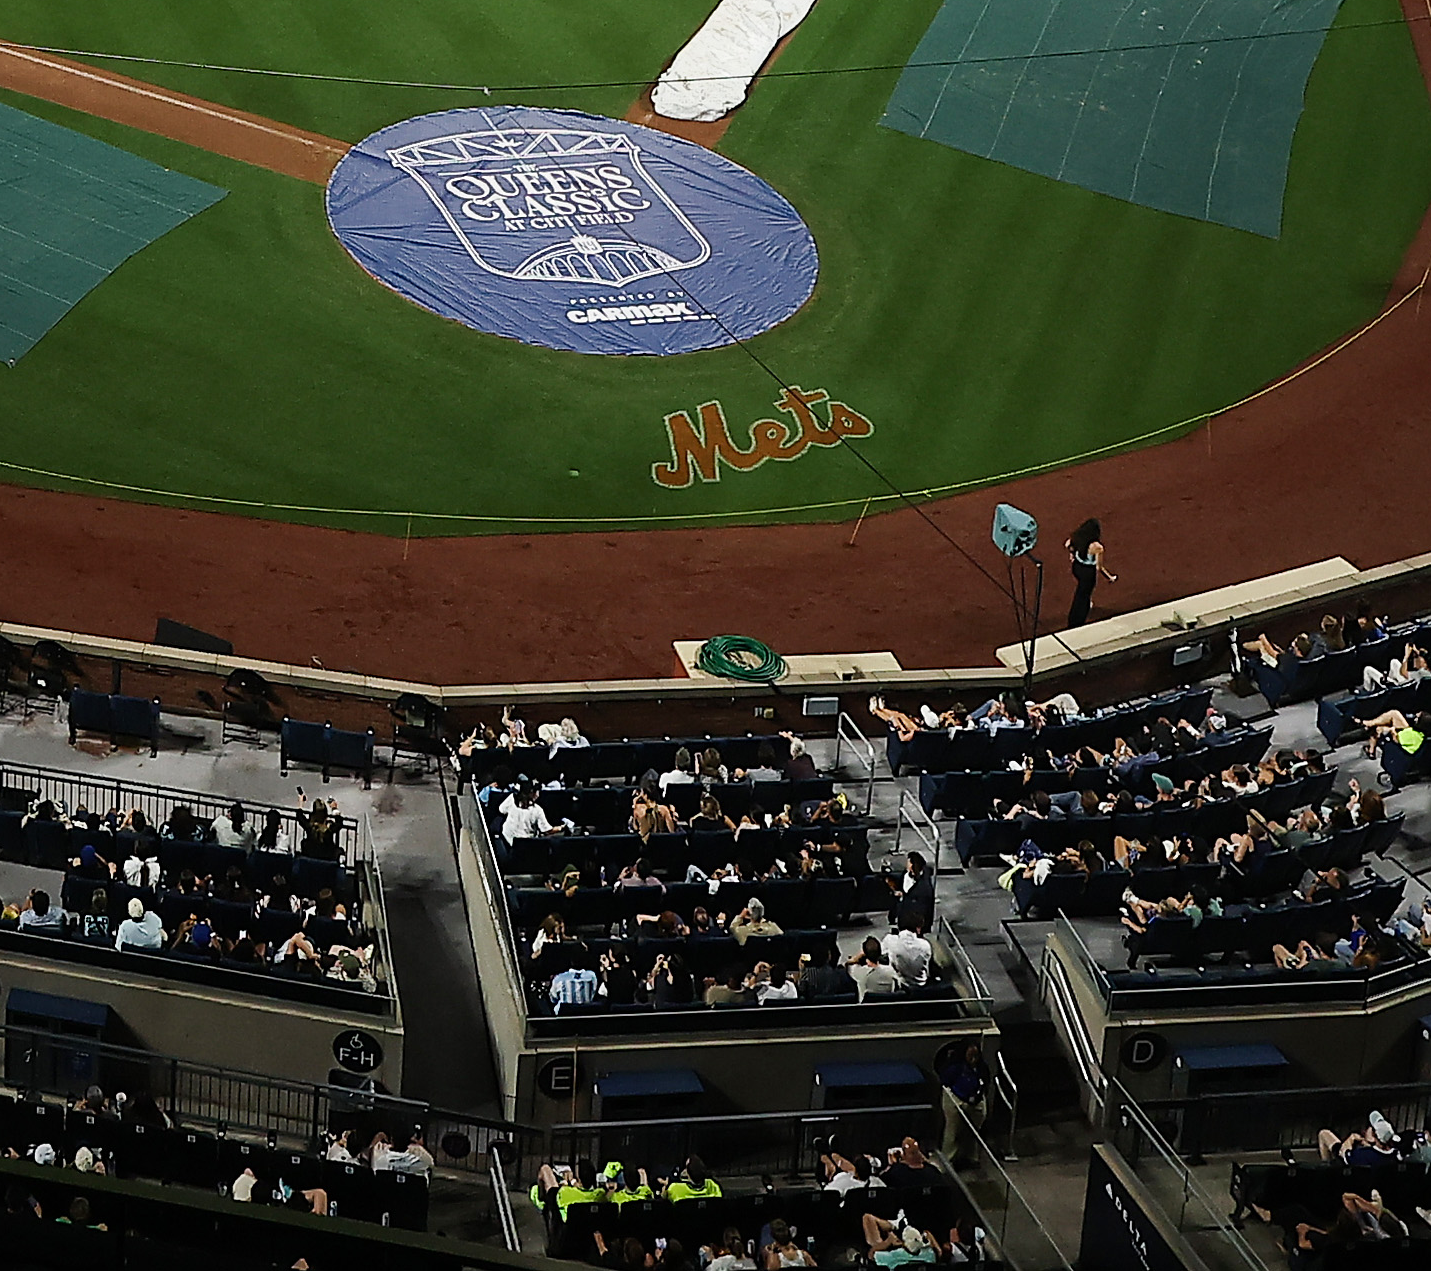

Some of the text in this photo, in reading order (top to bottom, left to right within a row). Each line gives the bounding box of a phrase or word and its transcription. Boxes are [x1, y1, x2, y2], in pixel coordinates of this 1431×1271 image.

[513, 163, 539, 174] THE
[444, 166, 636, 205] QUEENS
[460, 188, 652, 223] CLASSIC
[503, 210, 636, 232] AT CITI FIELD
[568, 291, 657, 306] PRESENTED
[651, 384, 875, 489] Mets
[338, 1047, 376, 1070] F-H
[1132, 1039, 1155, 1066] D
[552, 1066, 571, 1089] E
[1112, 1193, 1147, 1249] DELTA
